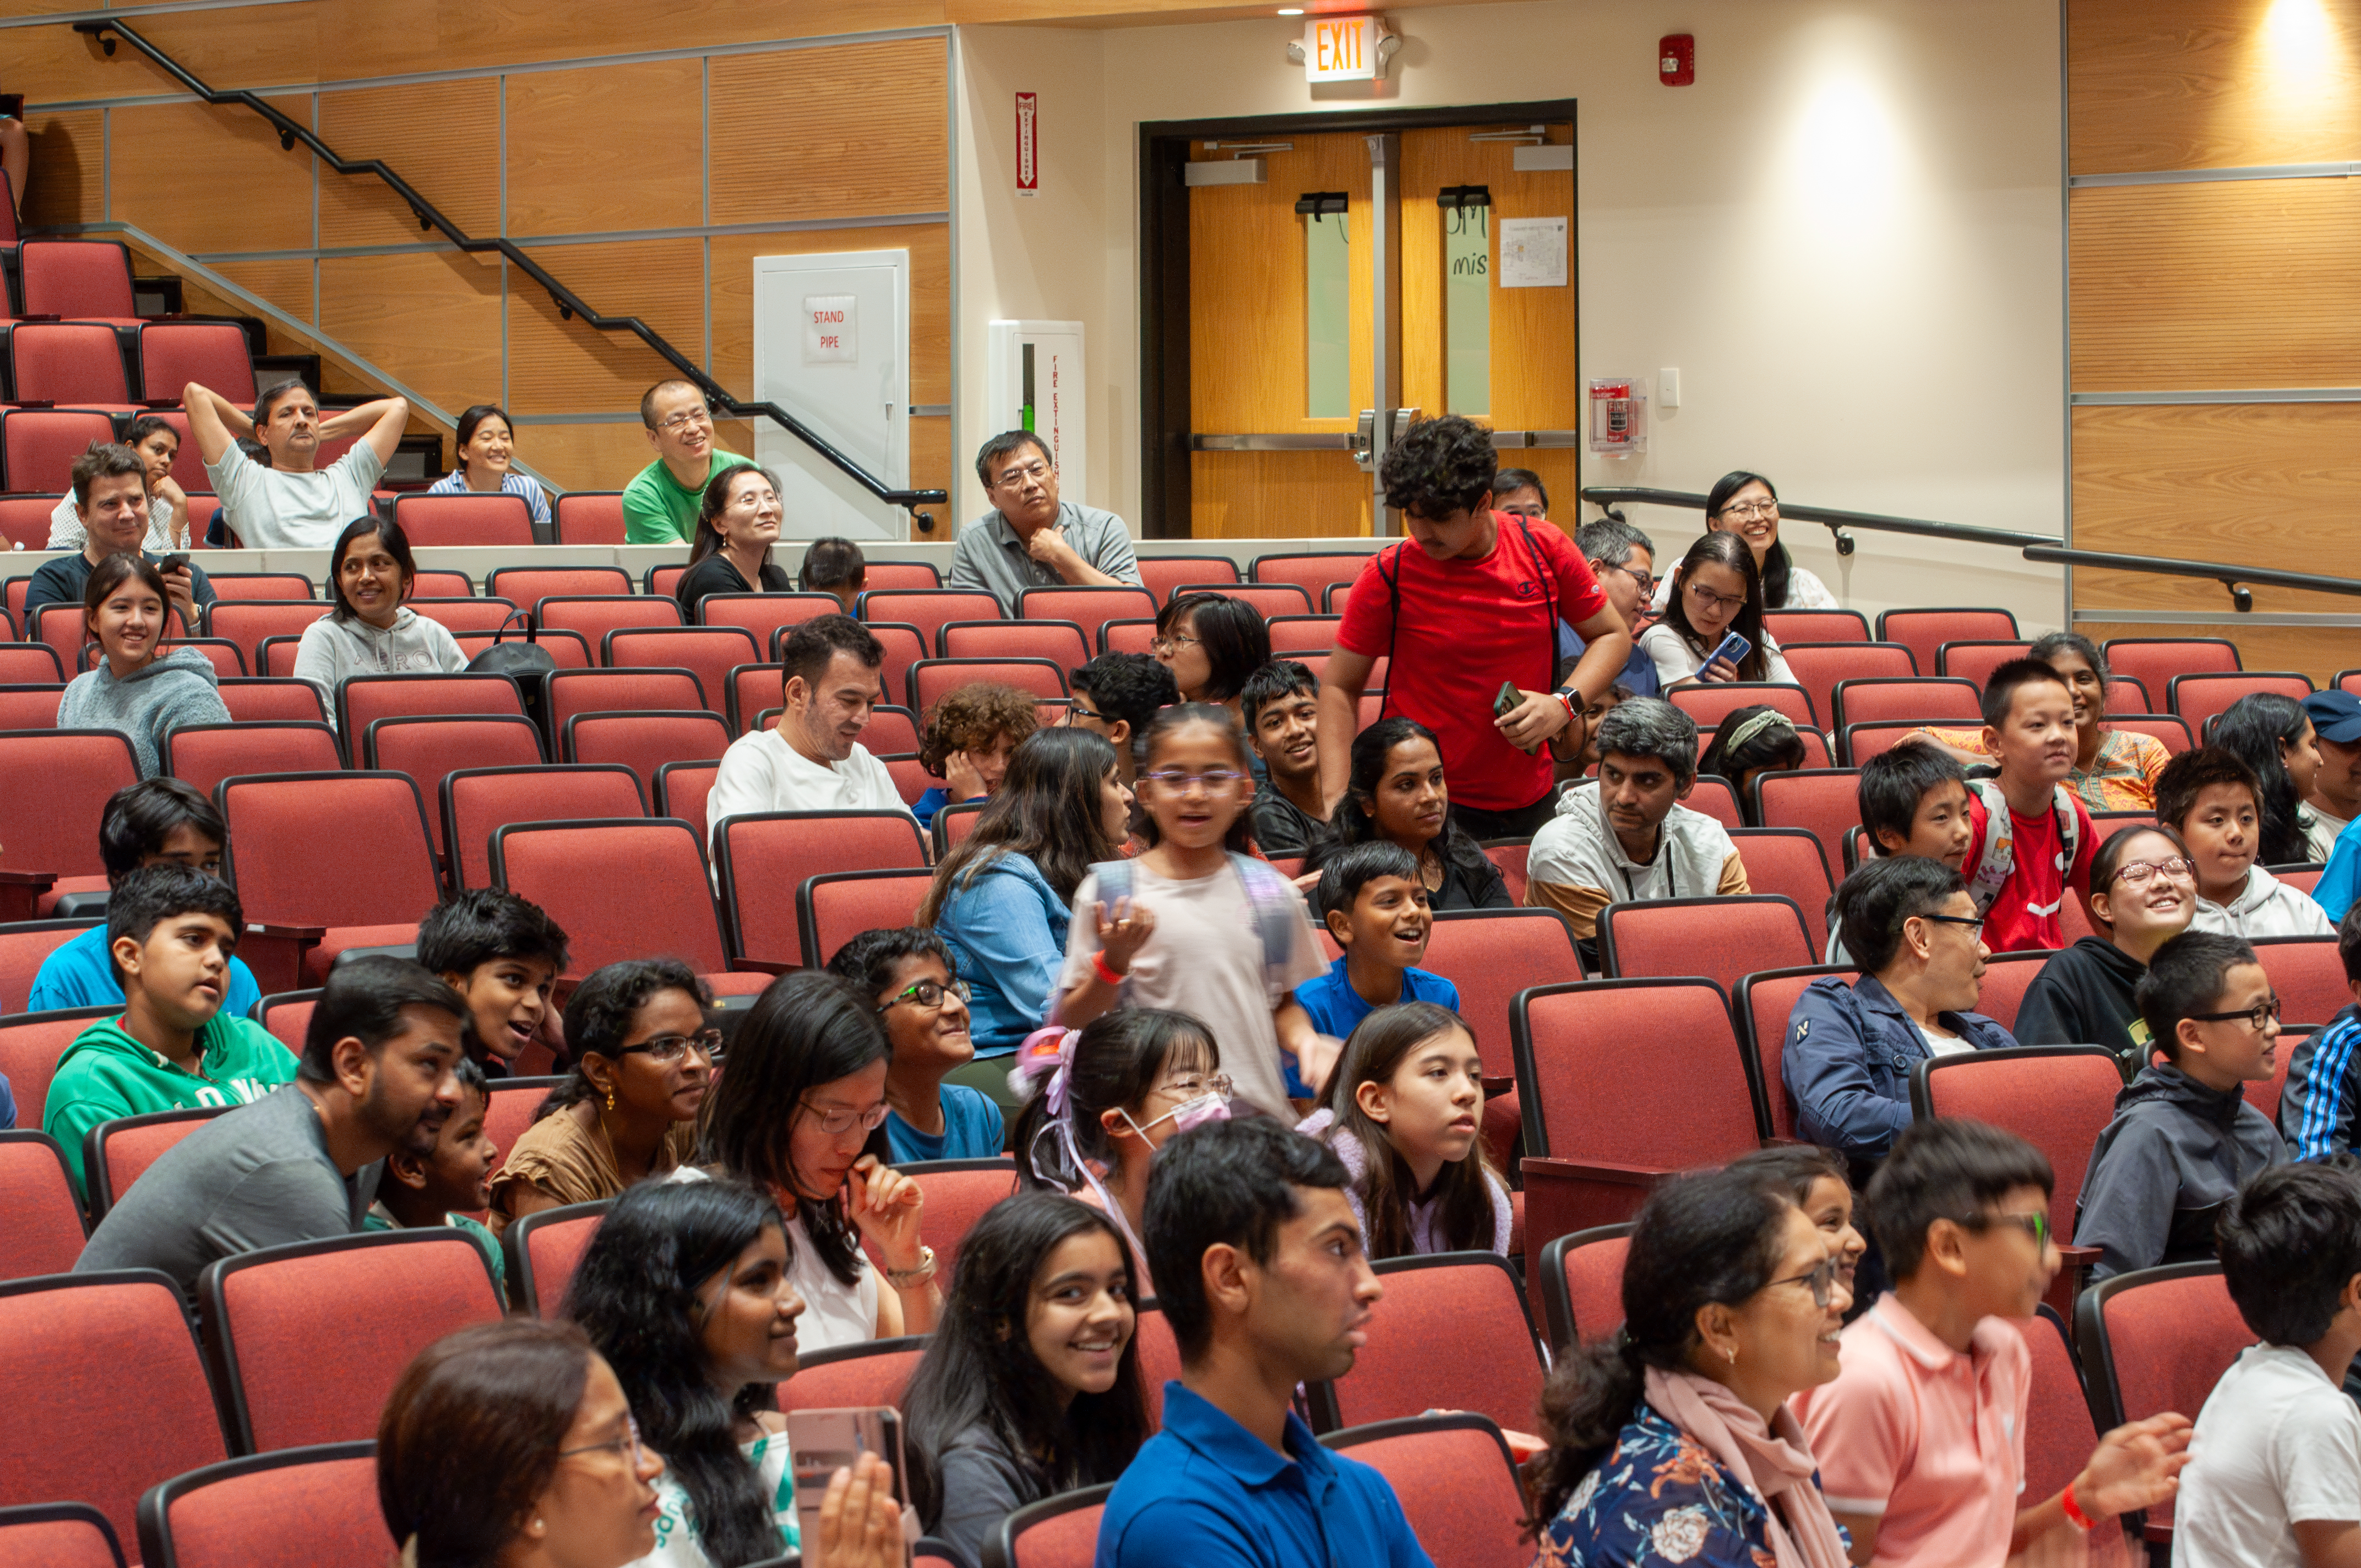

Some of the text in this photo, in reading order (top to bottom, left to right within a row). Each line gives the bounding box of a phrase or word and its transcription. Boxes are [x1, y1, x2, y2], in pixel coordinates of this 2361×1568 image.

[1315, 19, 1365, 71] EXIT
[1019, 102, 1033, 110] FIRE
[814, 311, 844, 323] STAND
[821, 336, 839, 348] PIPE
[1608, 401, 1628, 412] FIRE
